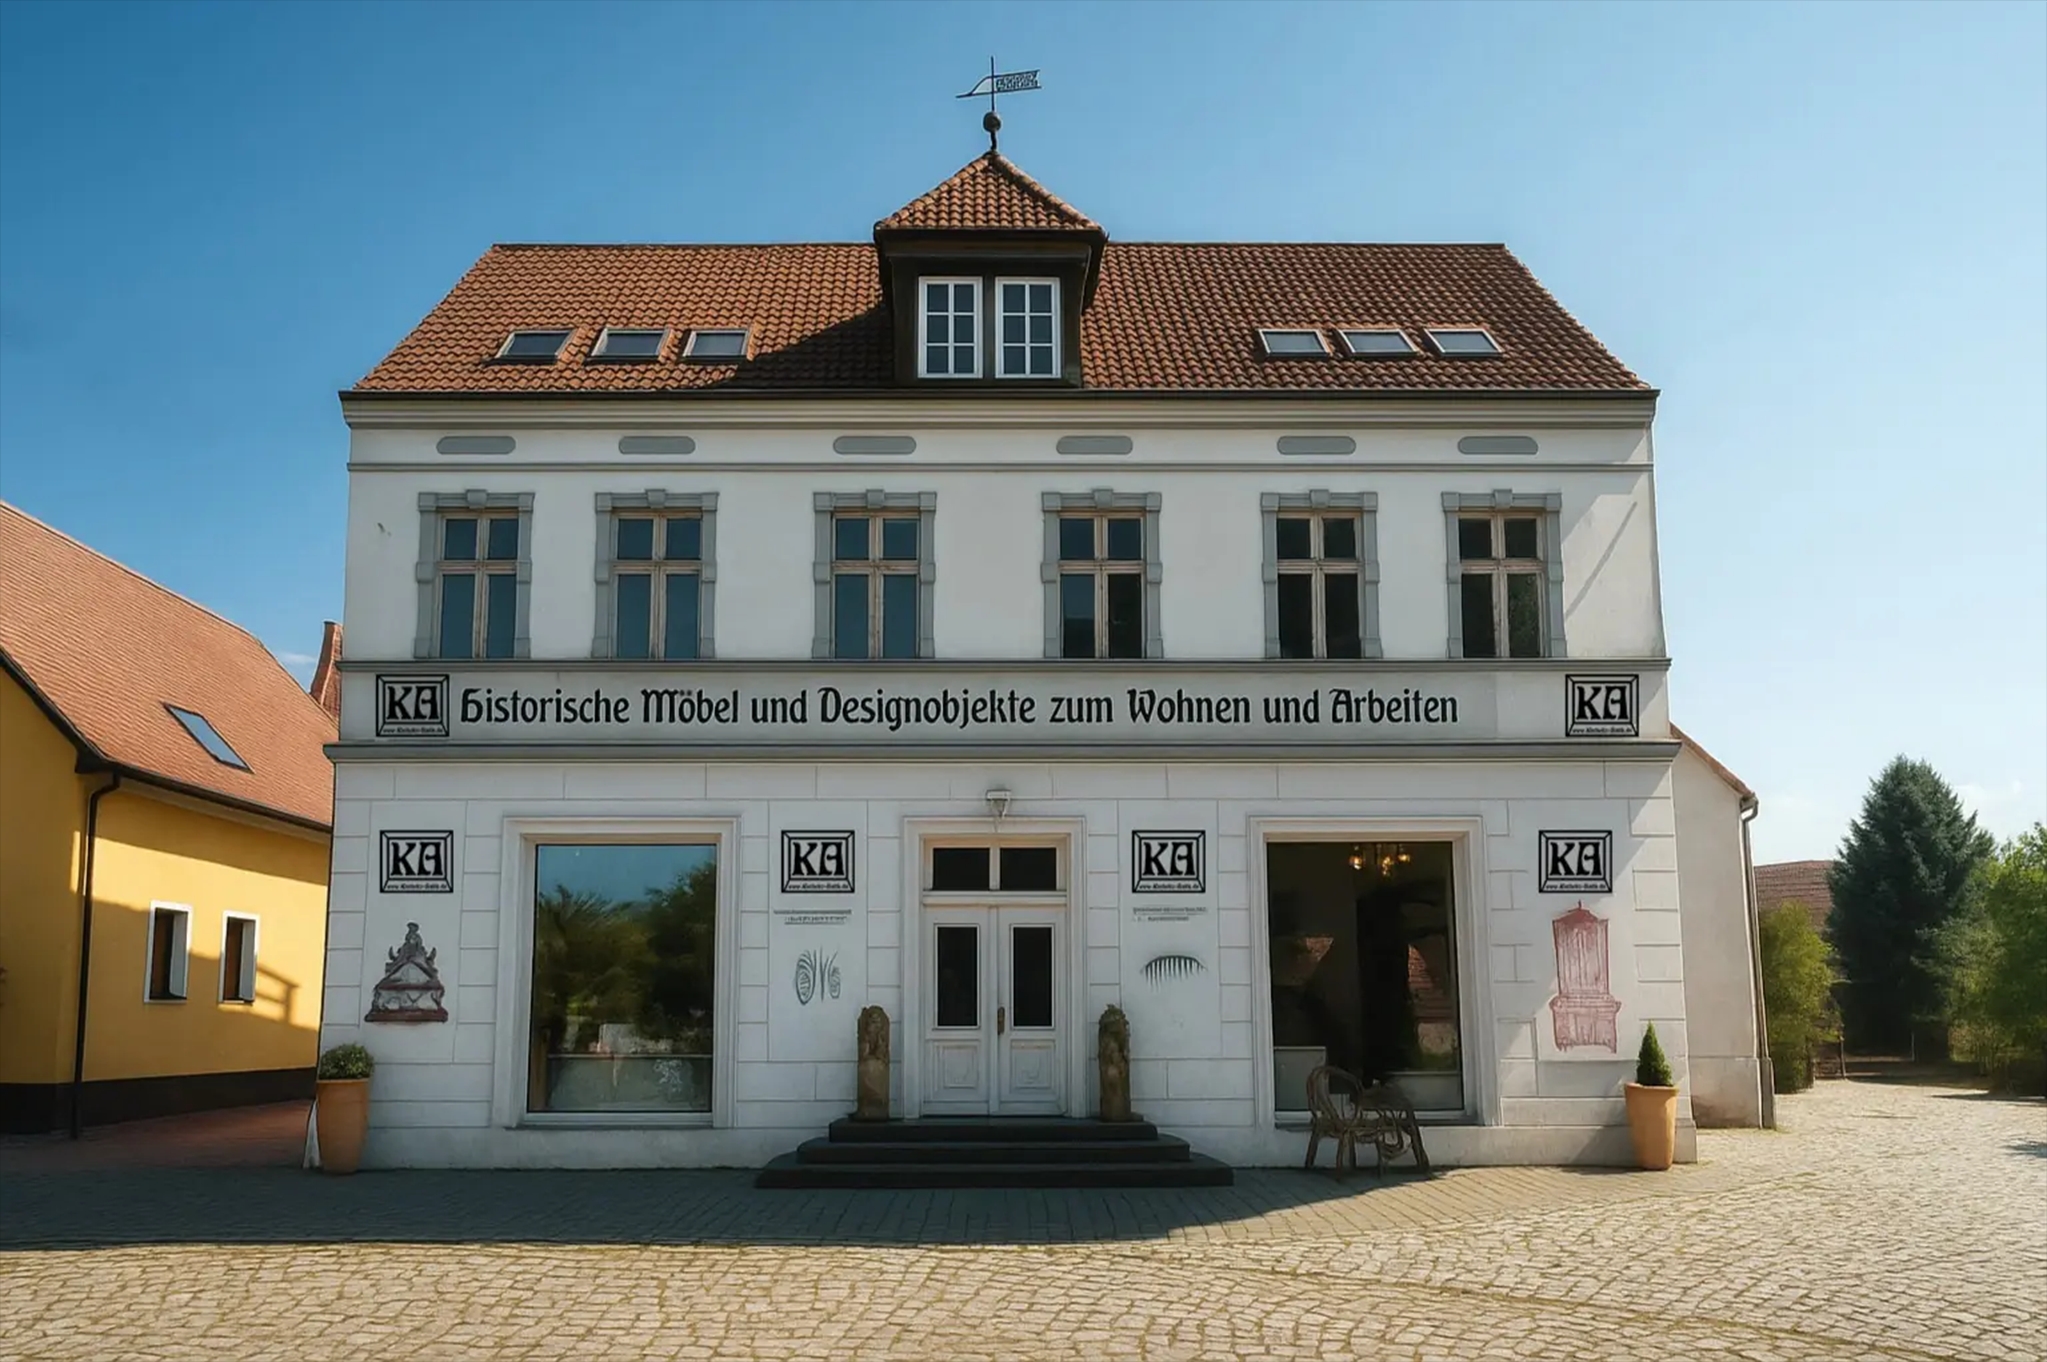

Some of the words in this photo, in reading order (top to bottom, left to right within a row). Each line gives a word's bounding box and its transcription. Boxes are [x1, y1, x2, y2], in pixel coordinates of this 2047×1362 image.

[386, 685, 440, 720] KA
[460, 687, 630, 724] Historische
[640, 688, 739, 724] Möbel
[751, 689, 808, 724] und
[817, 687, 1036, 732] Designobjekte
[1049, 696, 1114, 724] zum
[1126, 688, 1251, 724] Wohnen
[1262, 689, 1321, 724] und
[1328, 688, 1458, 724] Arbeiten
[1576, 685, 1629, 720] KA
[390, 842, 443, 876] KA
[791, 842, 845, 876] KA
[1142, 842, 1196, 876] KA
[1549, 842, 1602, 876] KA
